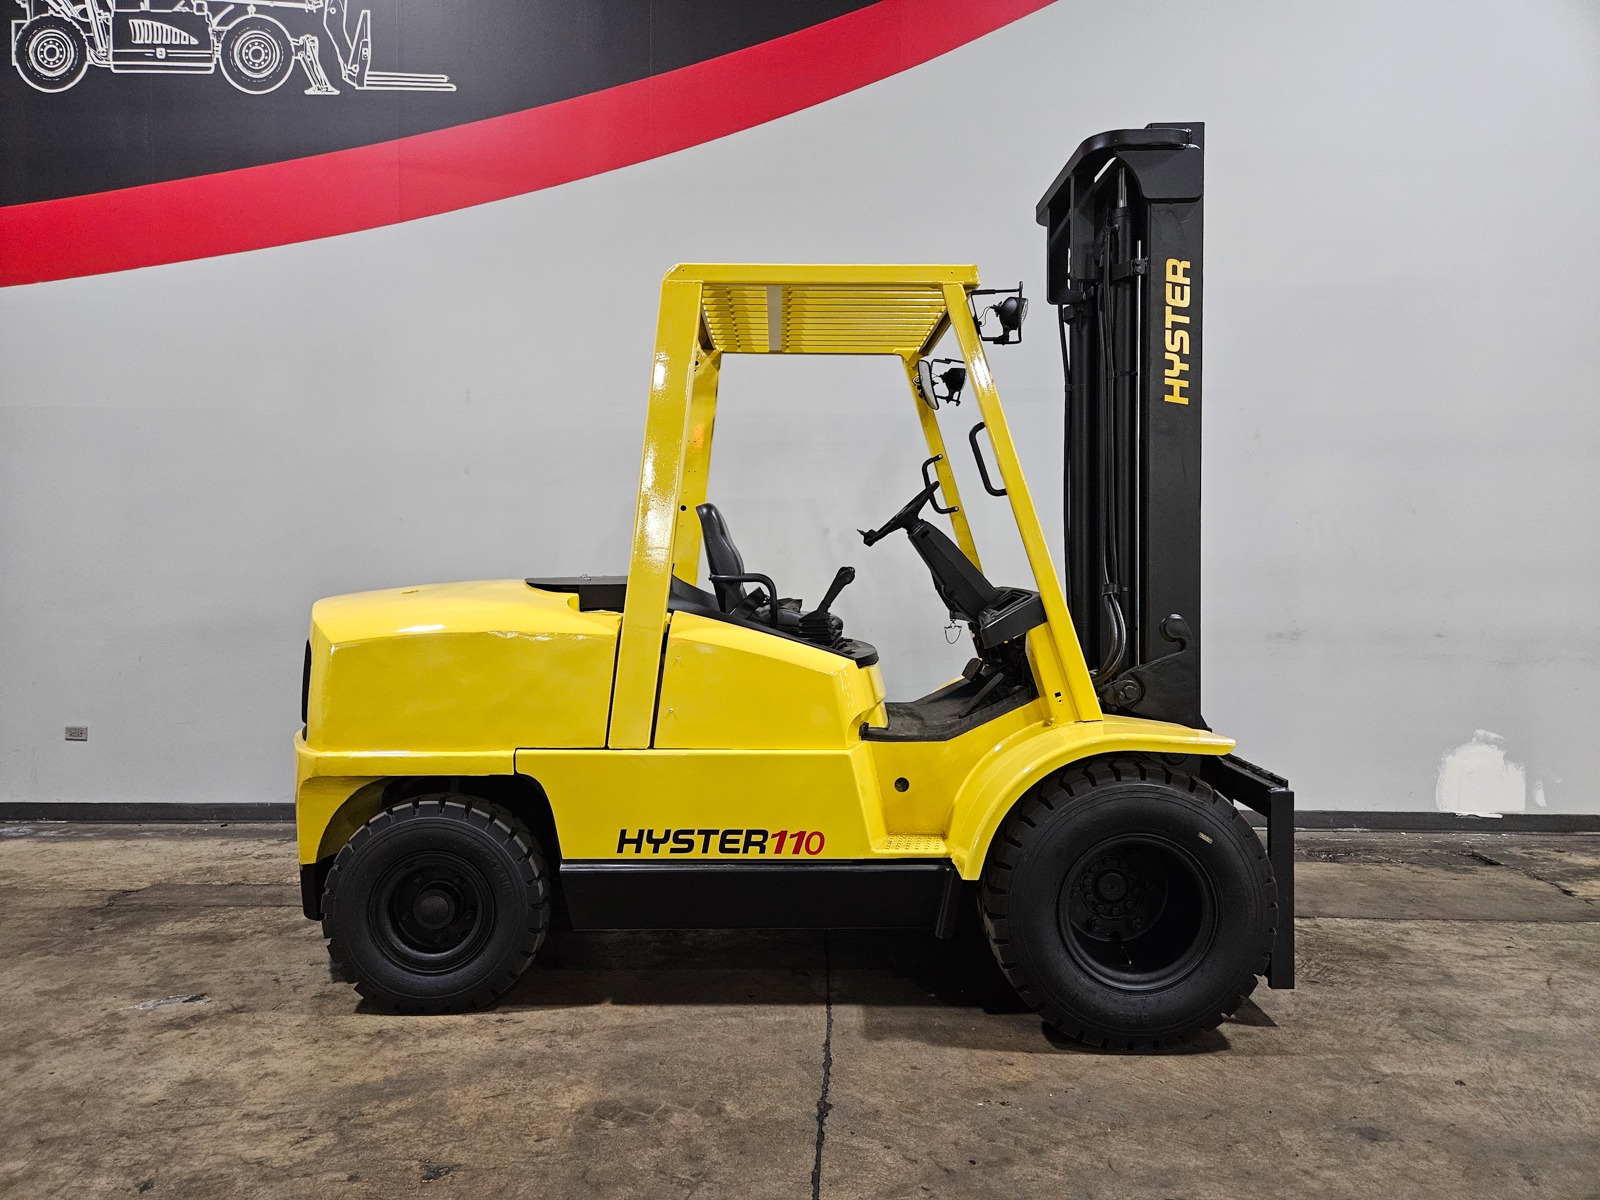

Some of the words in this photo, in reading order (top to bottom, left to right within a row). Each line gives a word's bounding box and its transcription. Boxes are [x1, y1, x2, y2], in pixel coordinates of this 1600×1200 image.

[1164, 258, 1191, 405] HYSTER
[616, 829, 769, 854] HYSTER
[771, 830, 826, 855] 110
